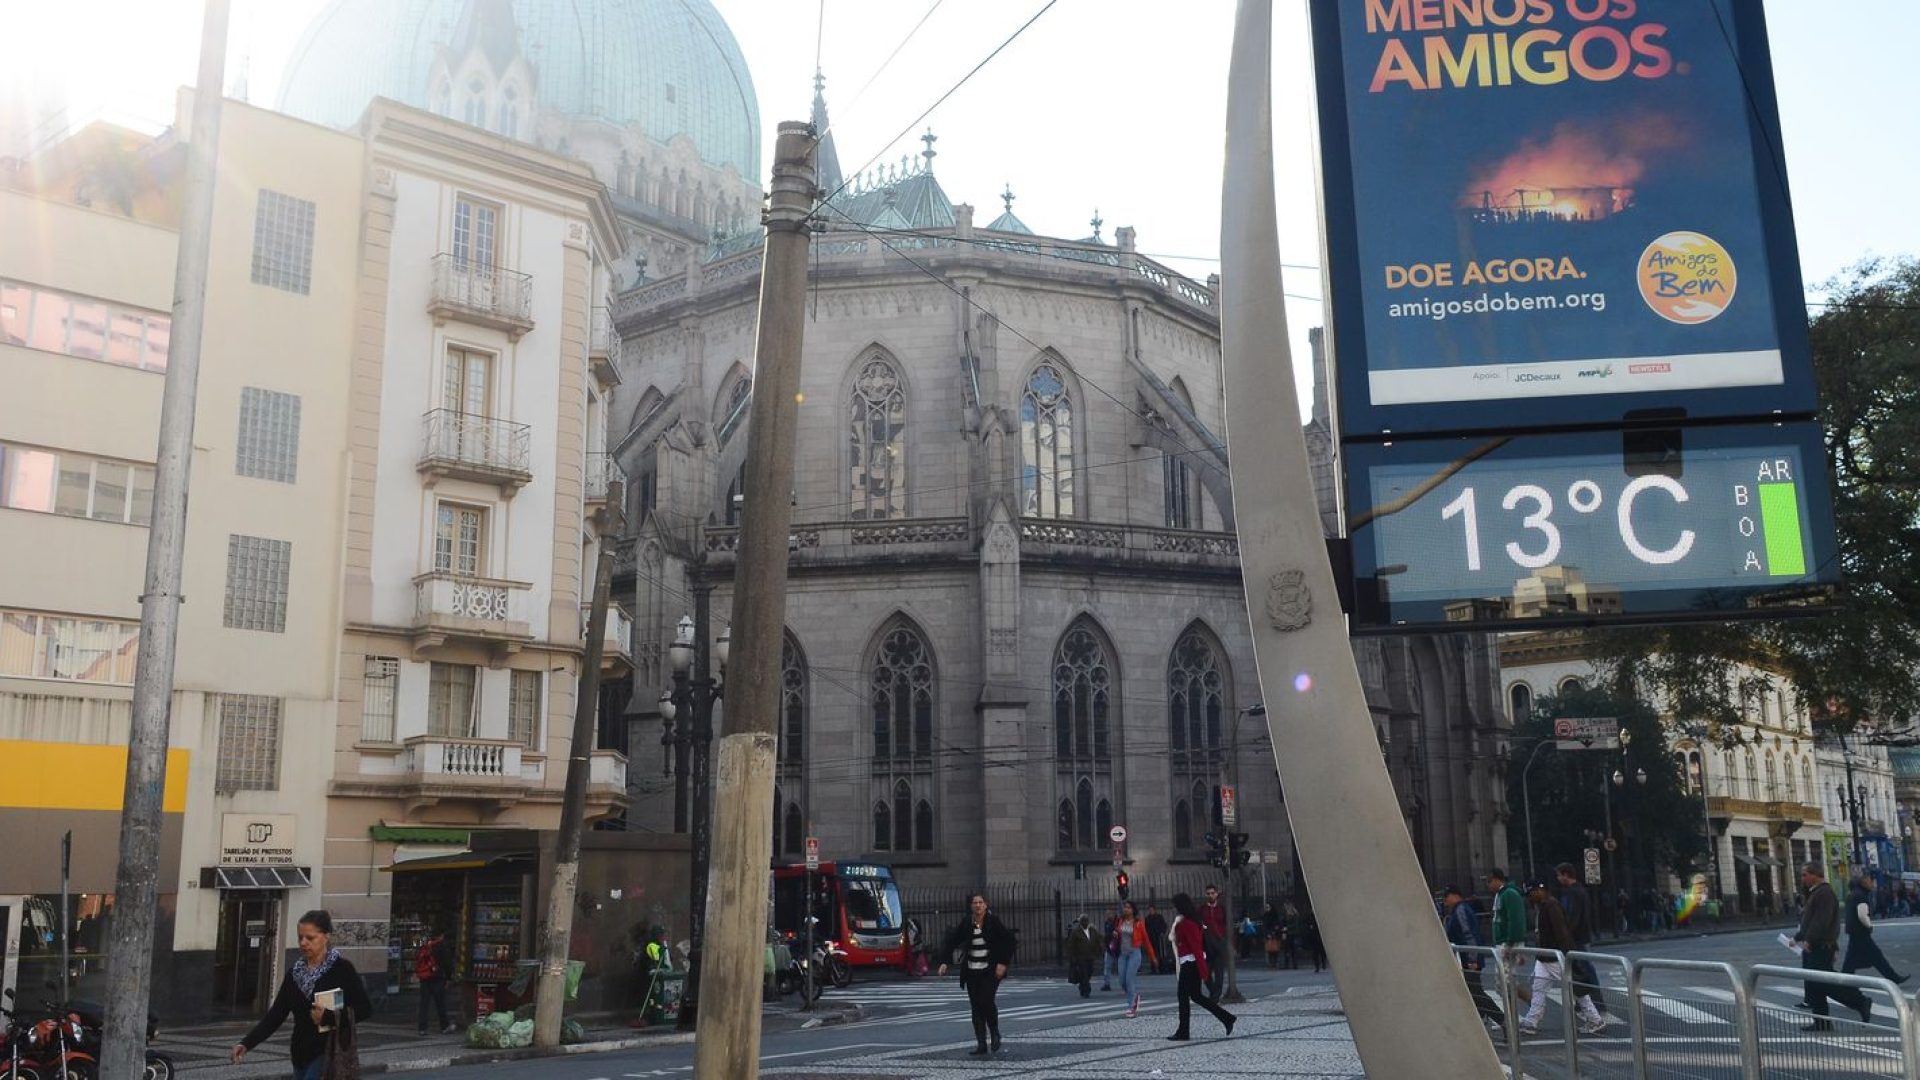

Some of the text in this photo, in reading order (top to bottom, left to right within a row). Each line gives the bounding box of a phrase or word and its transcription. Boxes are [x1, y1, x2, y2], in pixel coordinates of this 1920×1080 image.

[1365, 0, 1637, 32] MENOS OS
[1368, 23, 1691, 92] AMIGOS.
[1385, 256, 1588, 289] DOE AGORA.
[1648, 250, 1717, 269] Amigos
[1696, 265, 1718, 277] do
[1650, 272, 1726, 297] Bem
[1389, 292, 1606, 321] amigosdobem.org
[1757, 459, 1792, 481] AR
